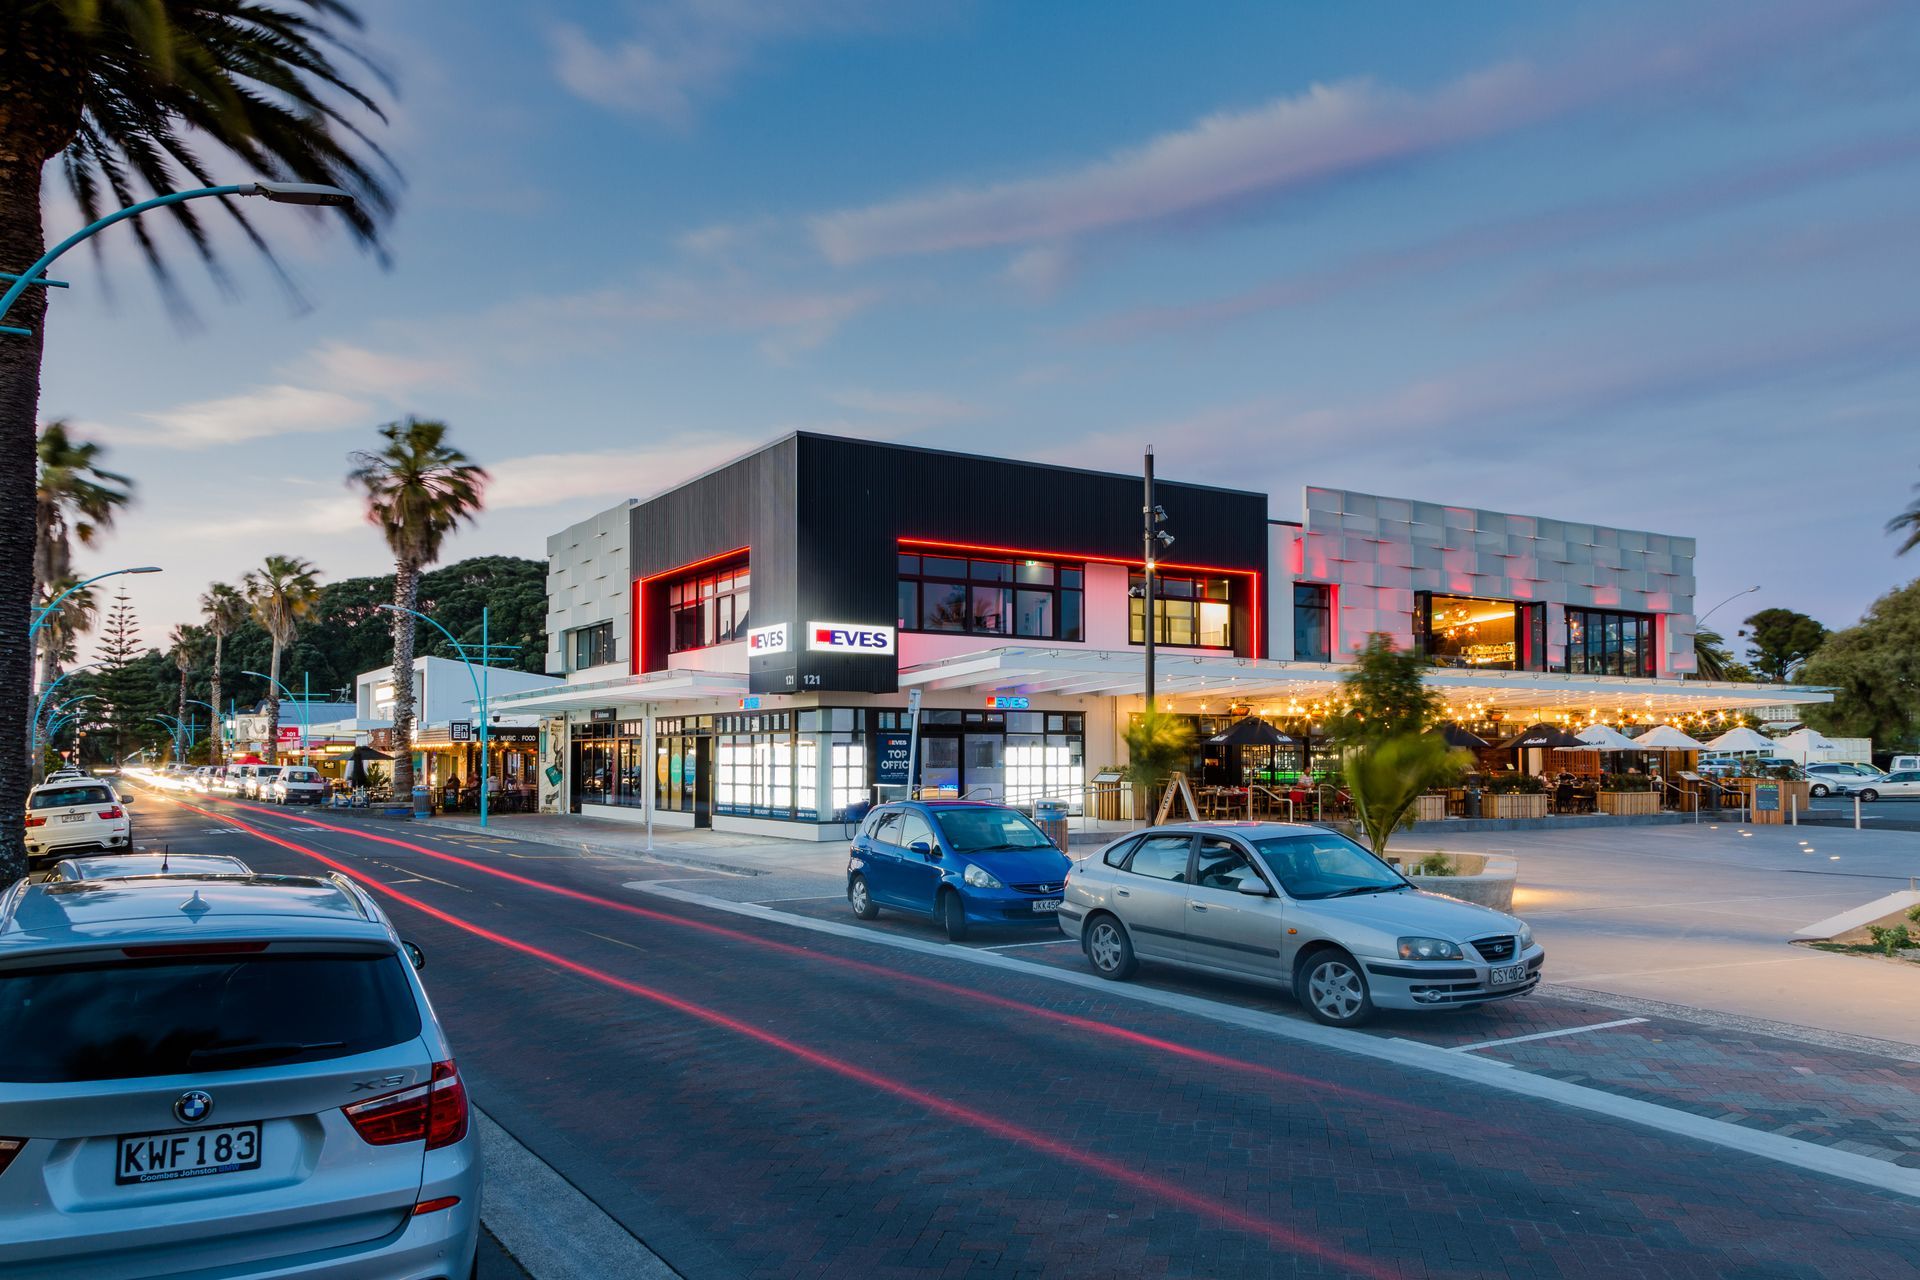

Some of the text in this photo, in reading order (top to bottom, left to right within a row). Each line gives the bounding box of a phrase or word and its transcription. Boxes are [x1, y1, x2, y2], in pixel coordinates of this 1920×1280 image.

[756, 630, 784, 649] EVES
[830, 630, 888, 648] EVES
[785, 675, 794, 685] 121
[803, 674, 821, 685] 121
[996, 696, 1029, 709] EVES
[888, 749, 907, 759] TOP
[881, 760, 910, 770] OFFIC
[349, 1074, 404, 1093] X3
[124, 1131, 256, 1174] KWF183
[139, 1163, 241, 1183] Coombes Johnston BMW
